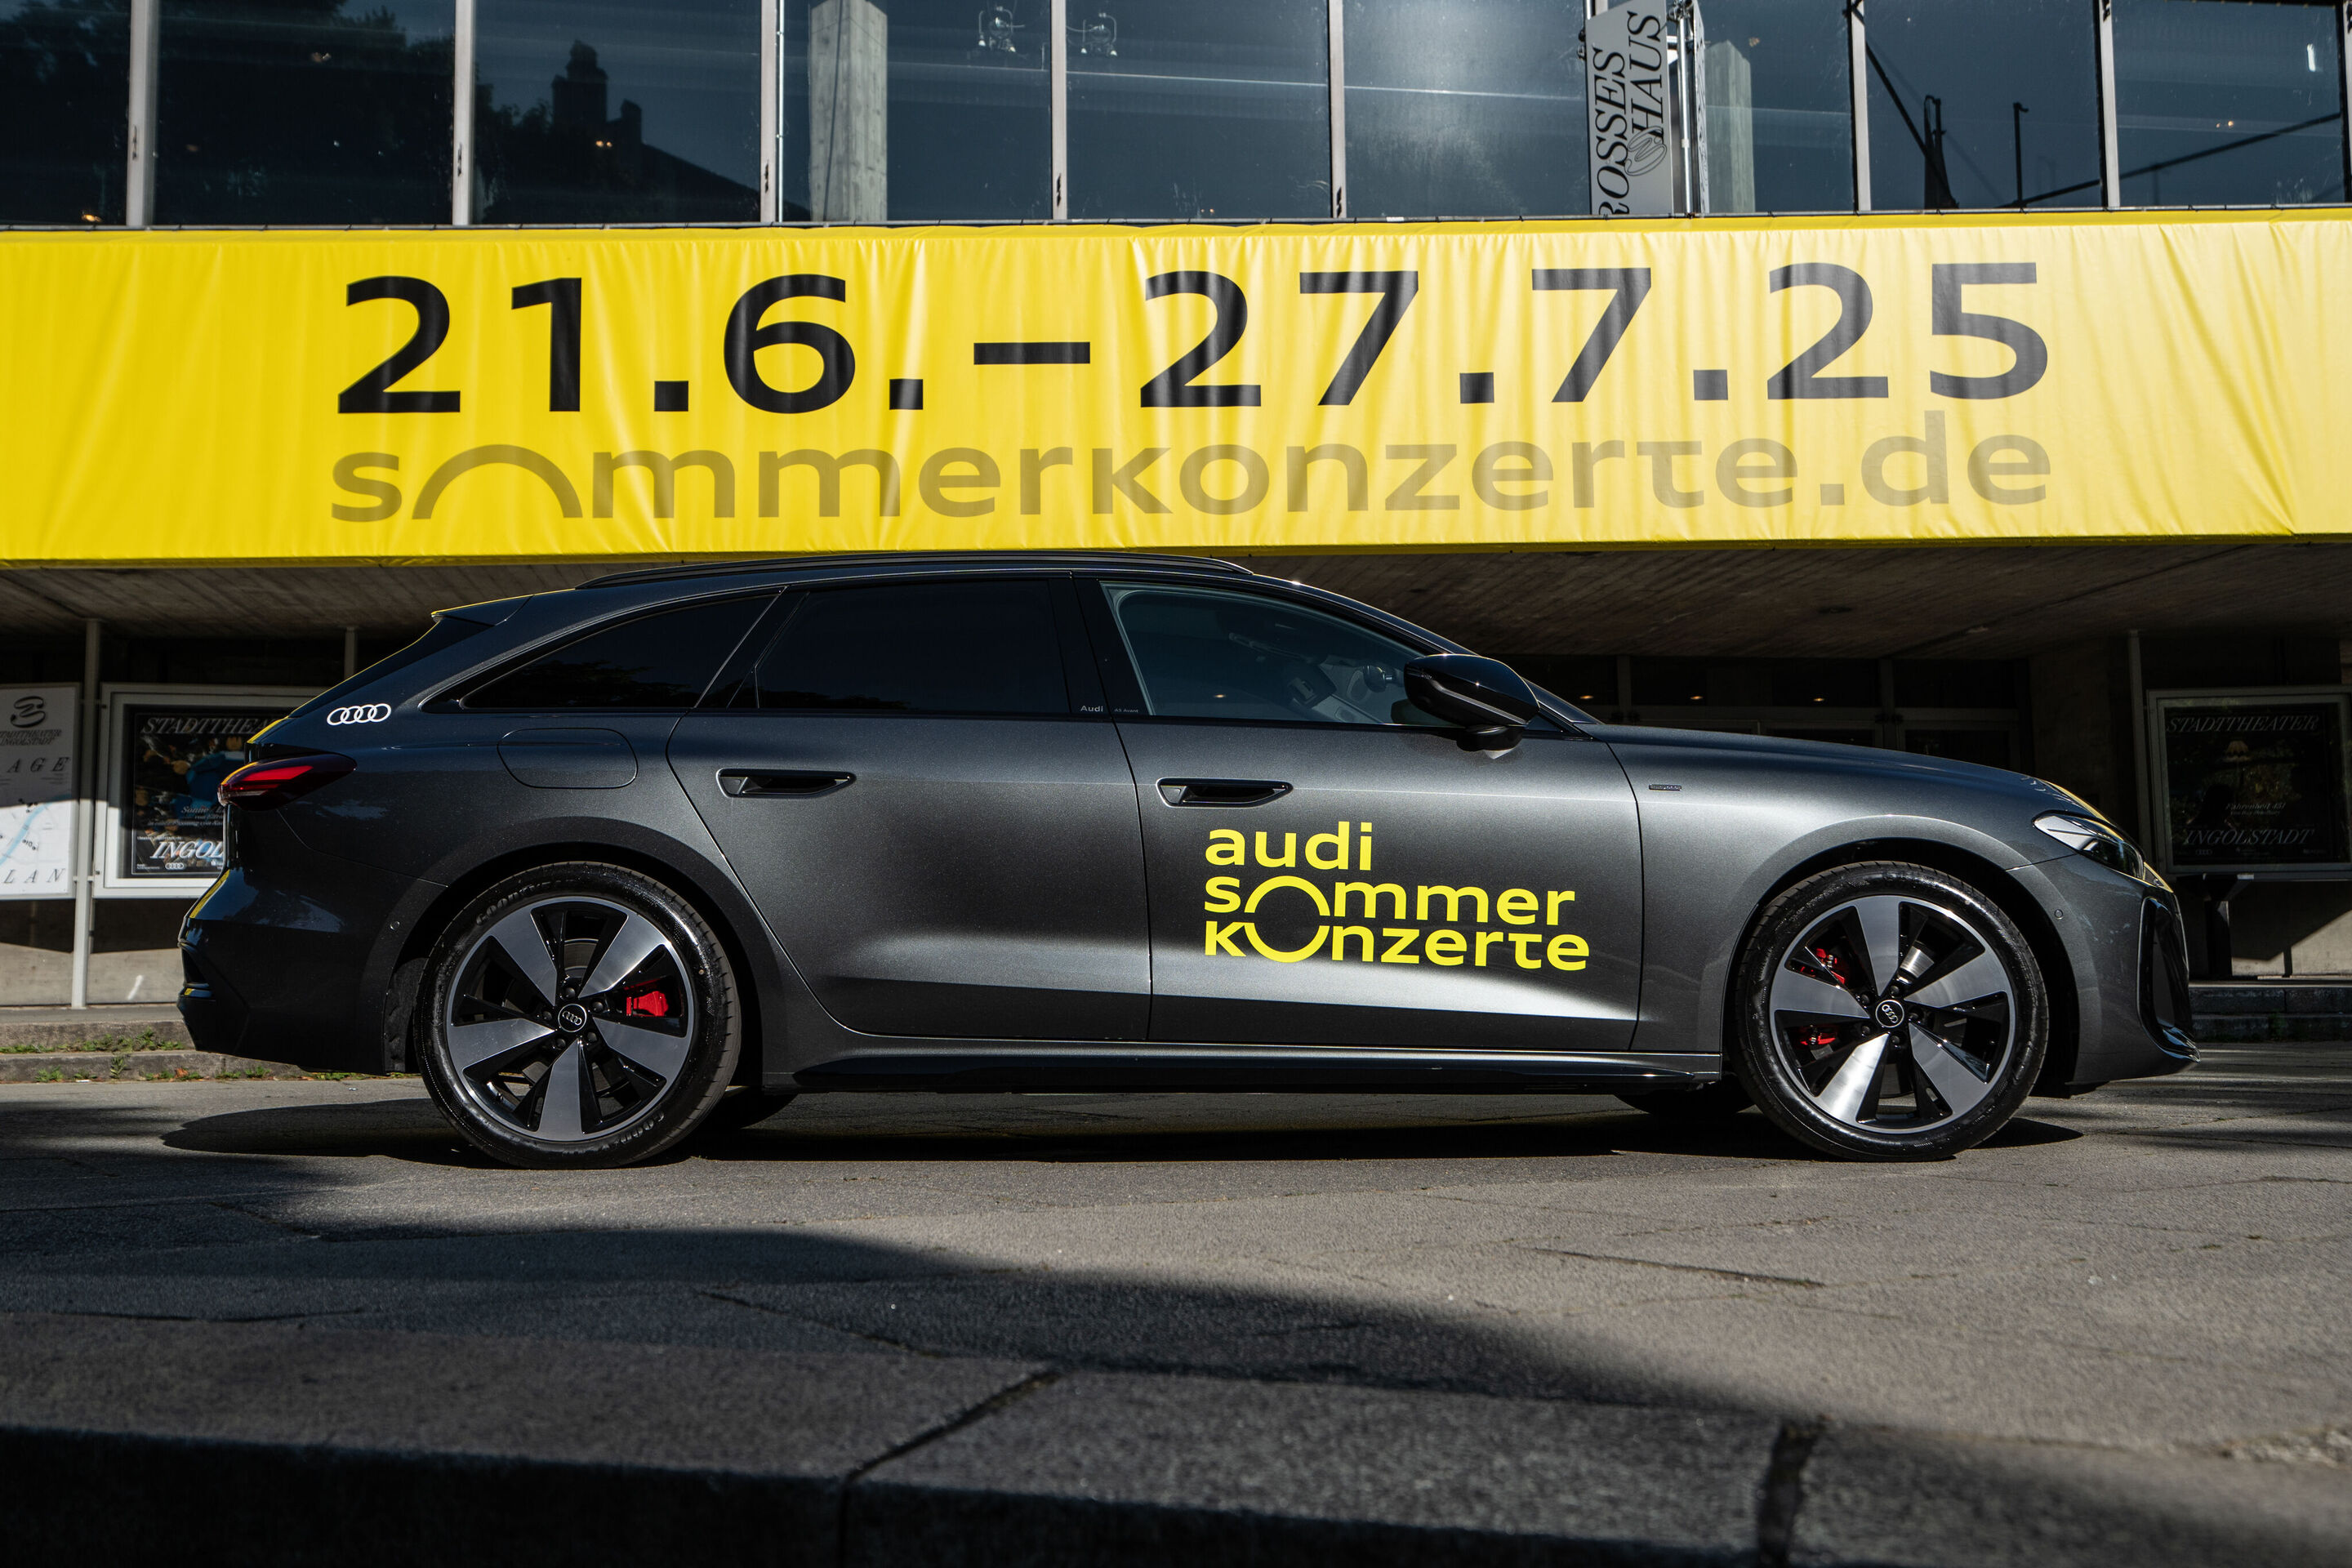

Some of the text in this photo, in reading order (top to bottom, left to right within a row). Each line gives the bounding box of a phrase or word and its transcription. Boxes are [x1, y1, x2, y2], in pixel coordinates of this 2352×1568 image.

[1627, 11, 1664, 145] HAUS
[140, 717, 275, 734] STADTTHEA
[2167, 715, 2320, 733] STADTTHEATER
[1205, 821, 1372, 871] audi
[2183, 828, 2315, 845] INGOLSTADT
[1204, 875, 1575, 926] sommer
[1204, 920, 1589, 971] konzerte
